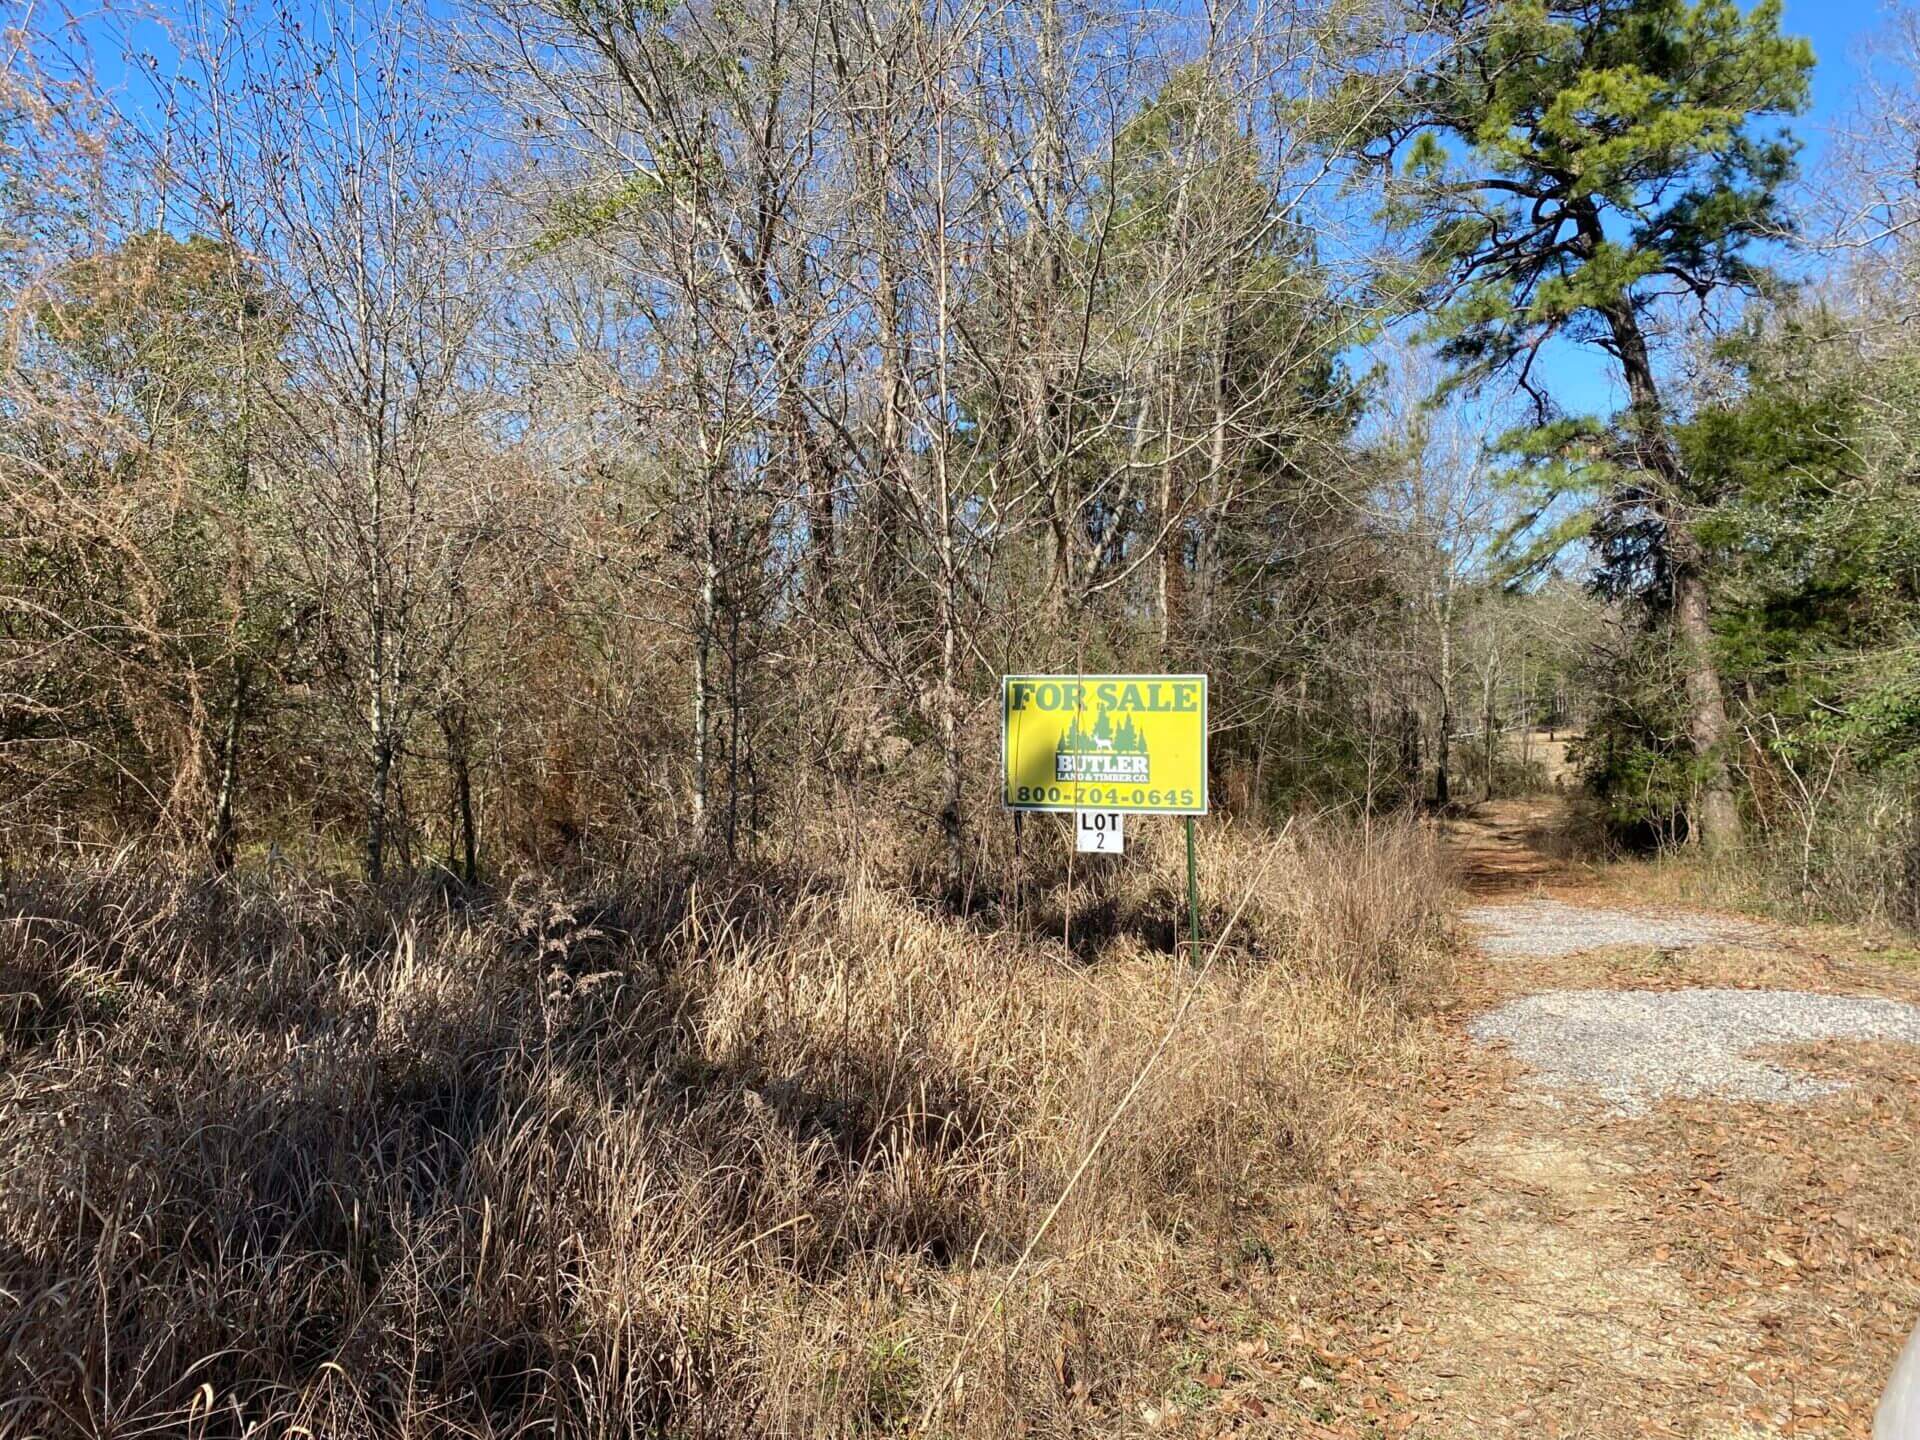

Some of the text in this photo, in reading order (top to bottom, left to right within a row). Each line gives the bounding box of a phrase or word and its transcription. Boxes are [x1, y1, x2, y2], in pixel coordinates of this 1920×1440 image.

[1012, 683, 1198, 712] FOR SALE
[1057, 755, 1148, 773] BUTLER
[1058, 773, 1084, 781] LAND
[1086, 773, 1093, 781] &
[1095, 773, 1132, 782] TIMBER
[1018, 786, 1194, 806] 800-704-0645
[1082, 813, 1119, 831] LOT
[1096, 832, 1105, 850] 2
